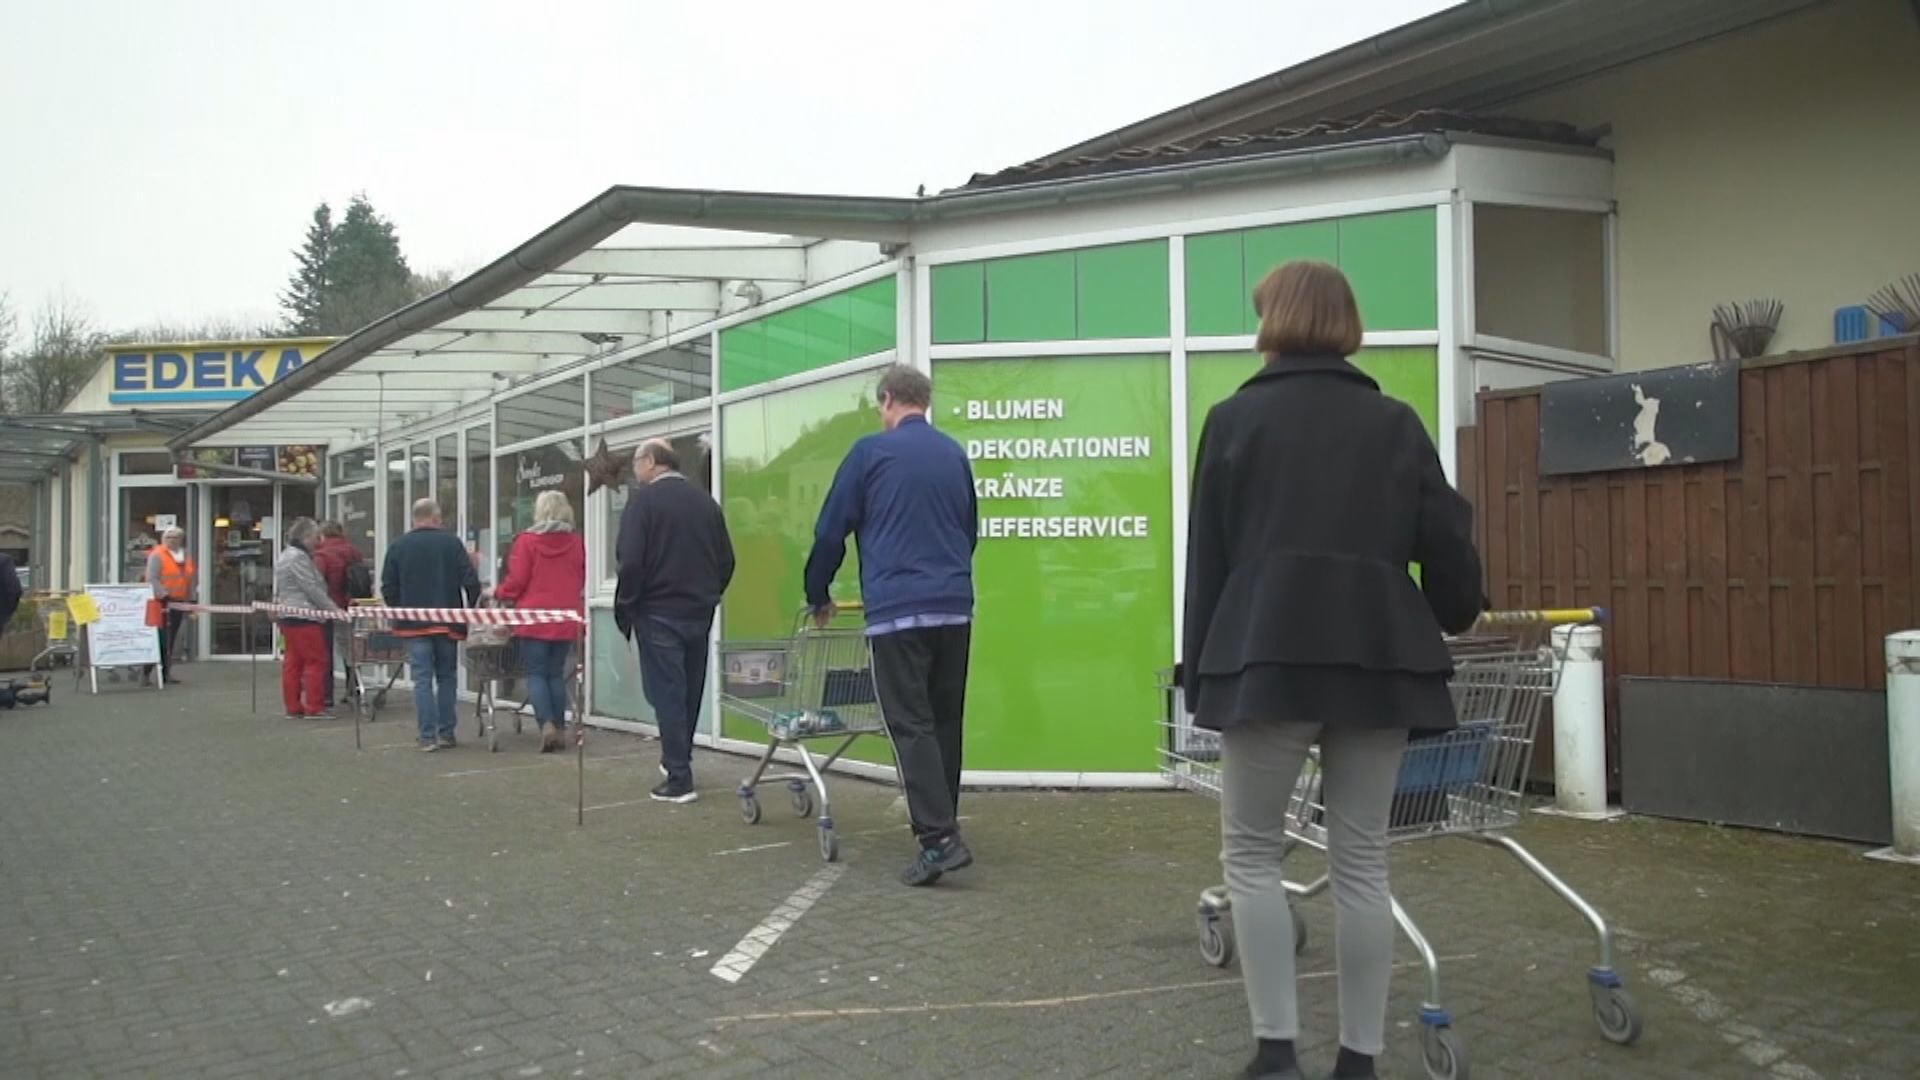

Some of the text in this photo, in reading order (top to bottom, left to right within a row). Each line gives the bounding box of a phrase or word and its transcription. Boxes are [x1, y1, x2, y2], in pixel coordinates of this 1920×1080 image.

[114, 349, 303, 390] EDEKA
[967, 399, 1063, 419] BLUMEN
[967, 437, 1149, 459] DEKORATIONEN
[977, 517, 1148, 537] IEFERSERVICE
